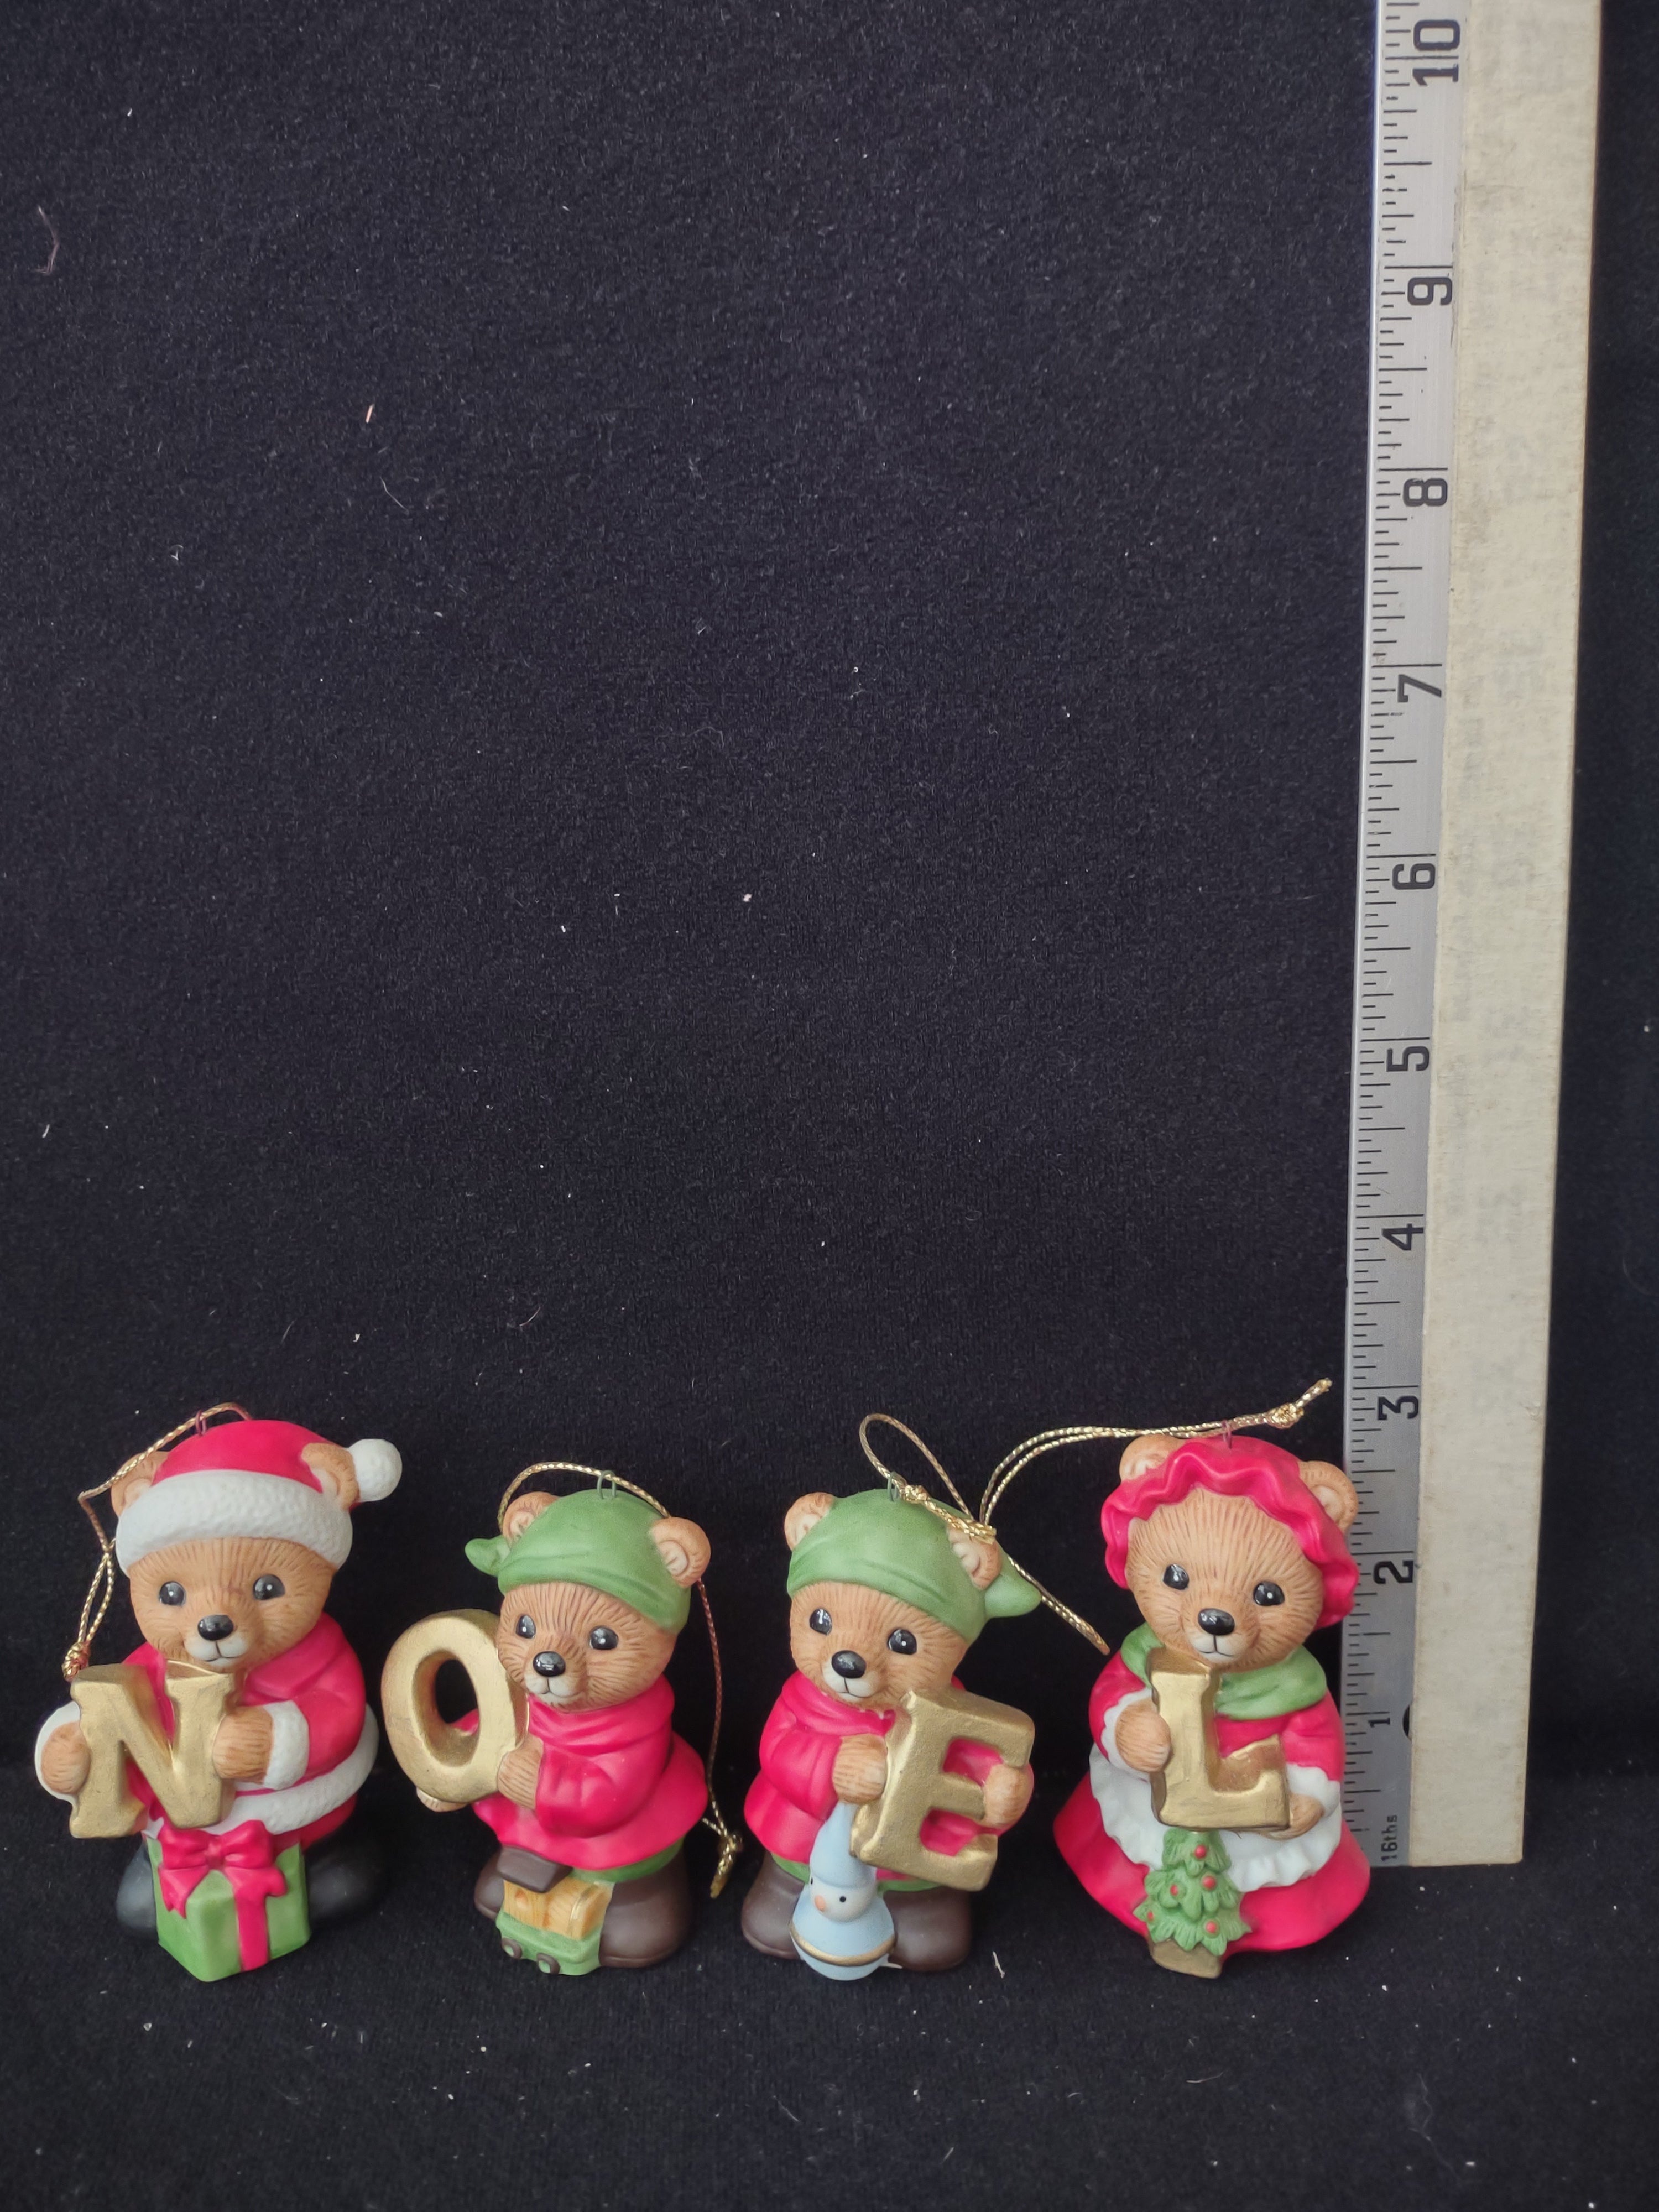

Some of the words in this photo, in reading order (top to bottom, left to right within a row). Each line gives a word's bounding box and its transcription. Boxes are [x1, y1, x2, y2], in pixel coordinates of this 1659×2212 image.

[1412, 19, 1460, 86] 10
[1407, 276, 1453, 306] 9
[1402, 478, 1448, 507] 8
[1397, 674, 1442, 703] 7
[1391, 863, 1436, 890] 6
[1386, 1045, 1430, 1072] 5
[1381, 1223, 1425, 1251] 4
[1376, 1395, 1419, 1421] 3
[1373, 1559, 1414, 1584] 2
[1368, 1717, 1391, 1728] 1
[1380, 1814, 1399, 1861] 16ths
